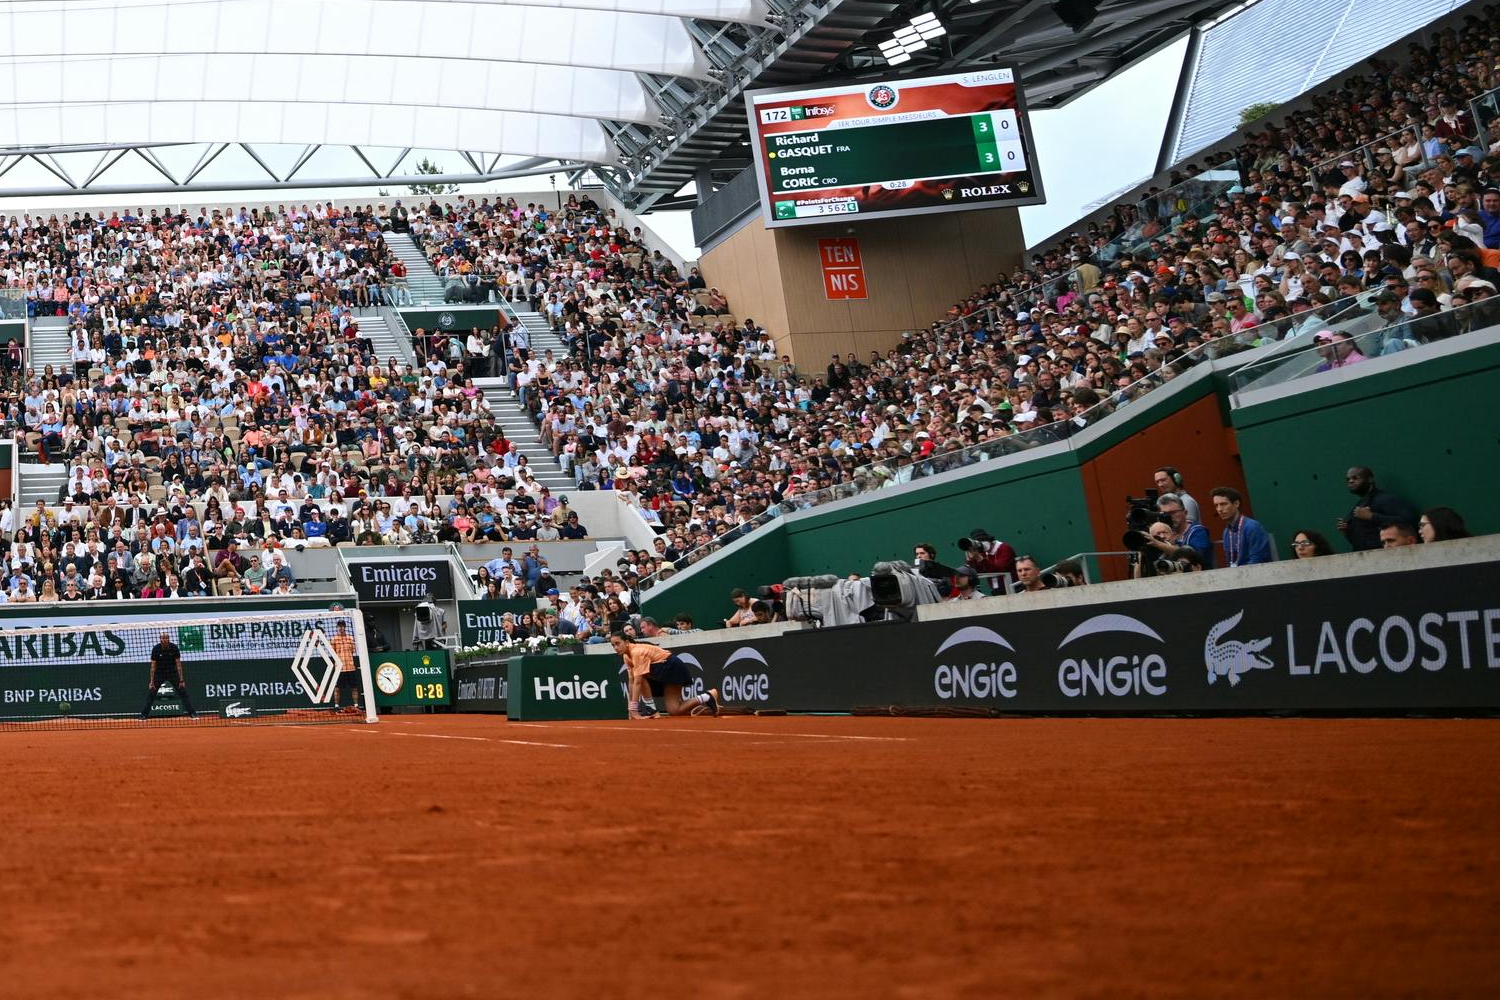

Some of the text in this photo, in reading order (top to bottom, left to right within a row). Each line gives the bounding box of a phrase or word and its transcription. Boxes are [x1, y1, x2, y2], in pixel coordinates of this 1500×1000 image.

[972, 72, 1010, 82] LENGLEN
[765, 111, 787, 121] 172
[979, 120, 1009, 132] 3 0
[775, 133, 819, 146] Richard
[777, 145, 833, 159] GASQUET
[985, 151, 1015, 163] 3 0
[780, 166, 815, 176] Borna
[782, 177, 819, 189] CORIC
[960, 184, 1011, 197] ROLEX
[824, 246, 855, 263] TEN
[830, 273, 859, 291] NIS
[361, 565, 437, 583] Emirates
[375, 581, 427, 598] FLY BETTER
[210, 621, 325, 640] BNP PARIBAS
[1286, 609, 1500, 675] LACOSTE
[412, 667, 442, 675] ROLEX
[4, 687, 102, 702] BNP PARIBAS
[206, 682, 304, 697] BNP PARIBAS
[416, 683, 444, 699] 0:28
[534, 675, 607, 700] Haier
